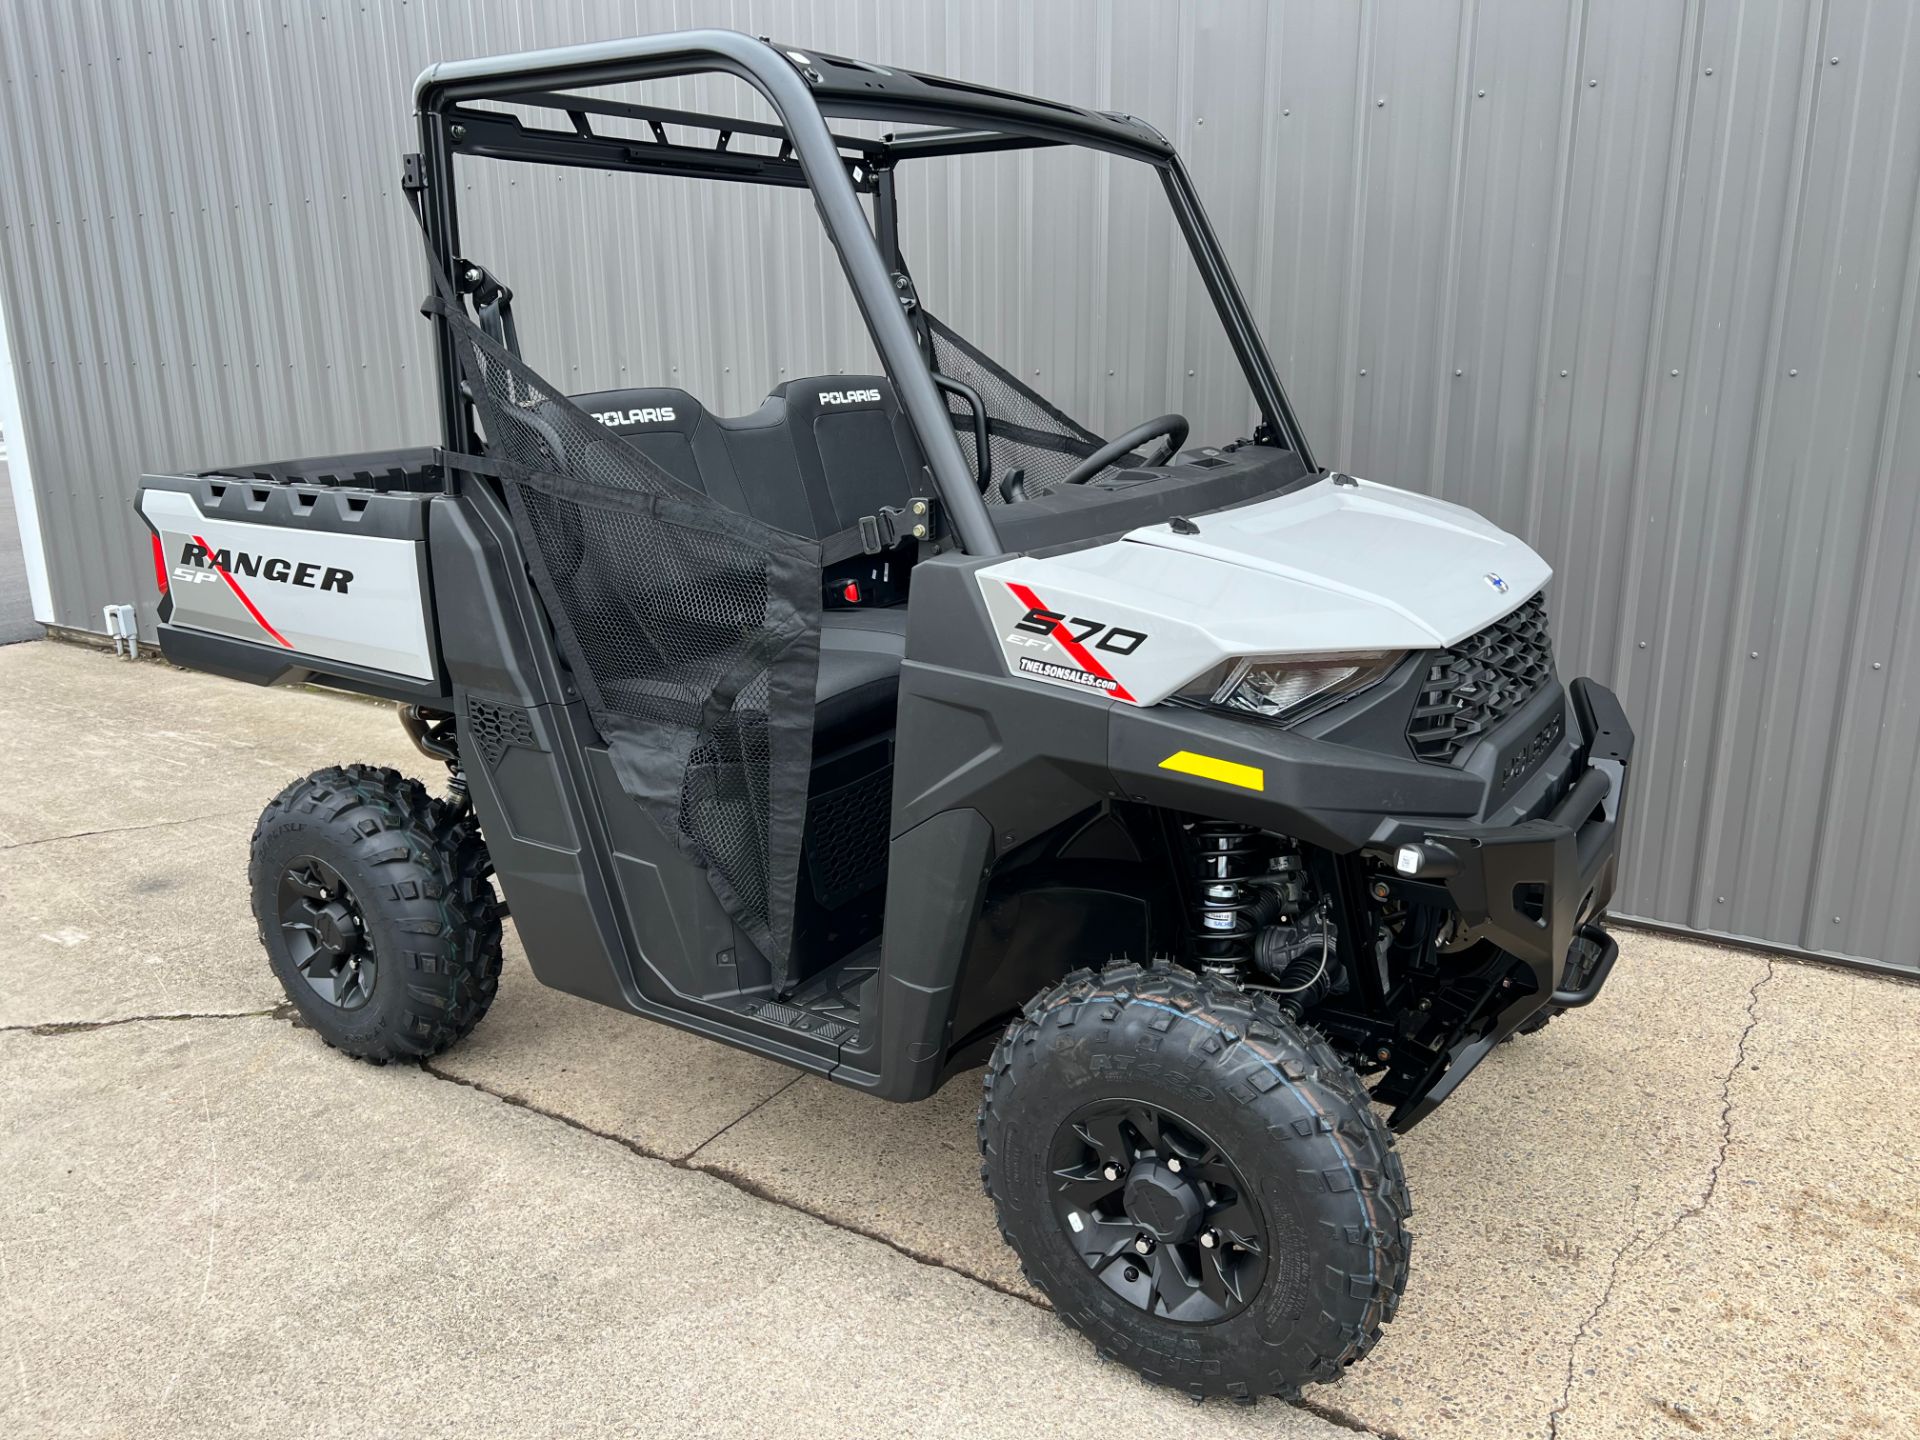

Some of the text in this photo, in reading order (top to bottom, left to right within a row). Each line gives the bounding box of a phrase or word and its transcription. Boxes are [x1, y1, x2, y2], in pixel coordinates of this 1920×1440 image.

[818, 389, 881, 405] POLARIS
[172, 567, 218, 584] SP
[180, 543, 354, 594] RANGER
[1005, 633, 1053, 651] EFI
[1014, 607, 1148, 656] 570
[1020, 658, 1117, 690] TNELSONSALES.com
